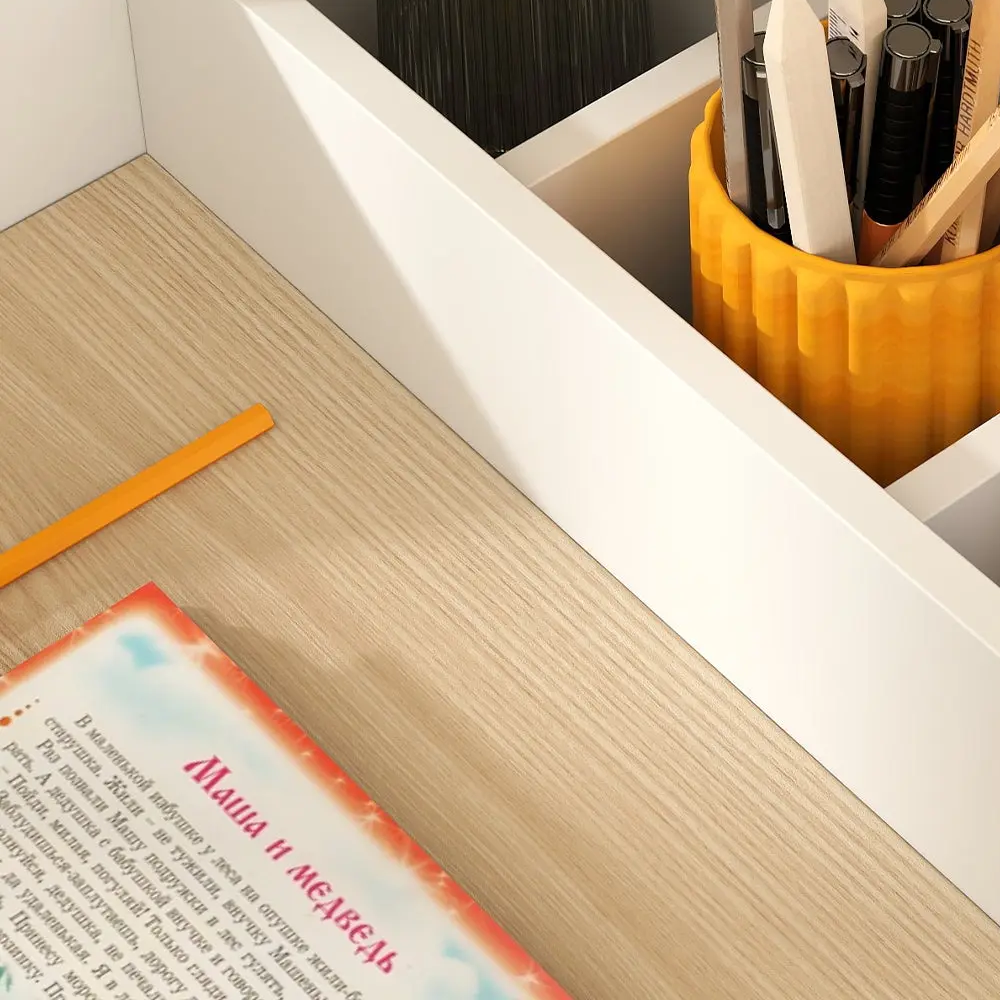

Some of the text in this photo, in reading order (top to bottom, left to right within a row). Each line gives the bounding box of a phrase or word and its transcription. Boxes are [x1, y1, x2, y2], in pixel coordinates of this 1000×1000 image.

[958, 39, 983, 139] HARDTMUTH
[183, 755, 269, 838] Маша
[285, 863, 398, 974] медведь
